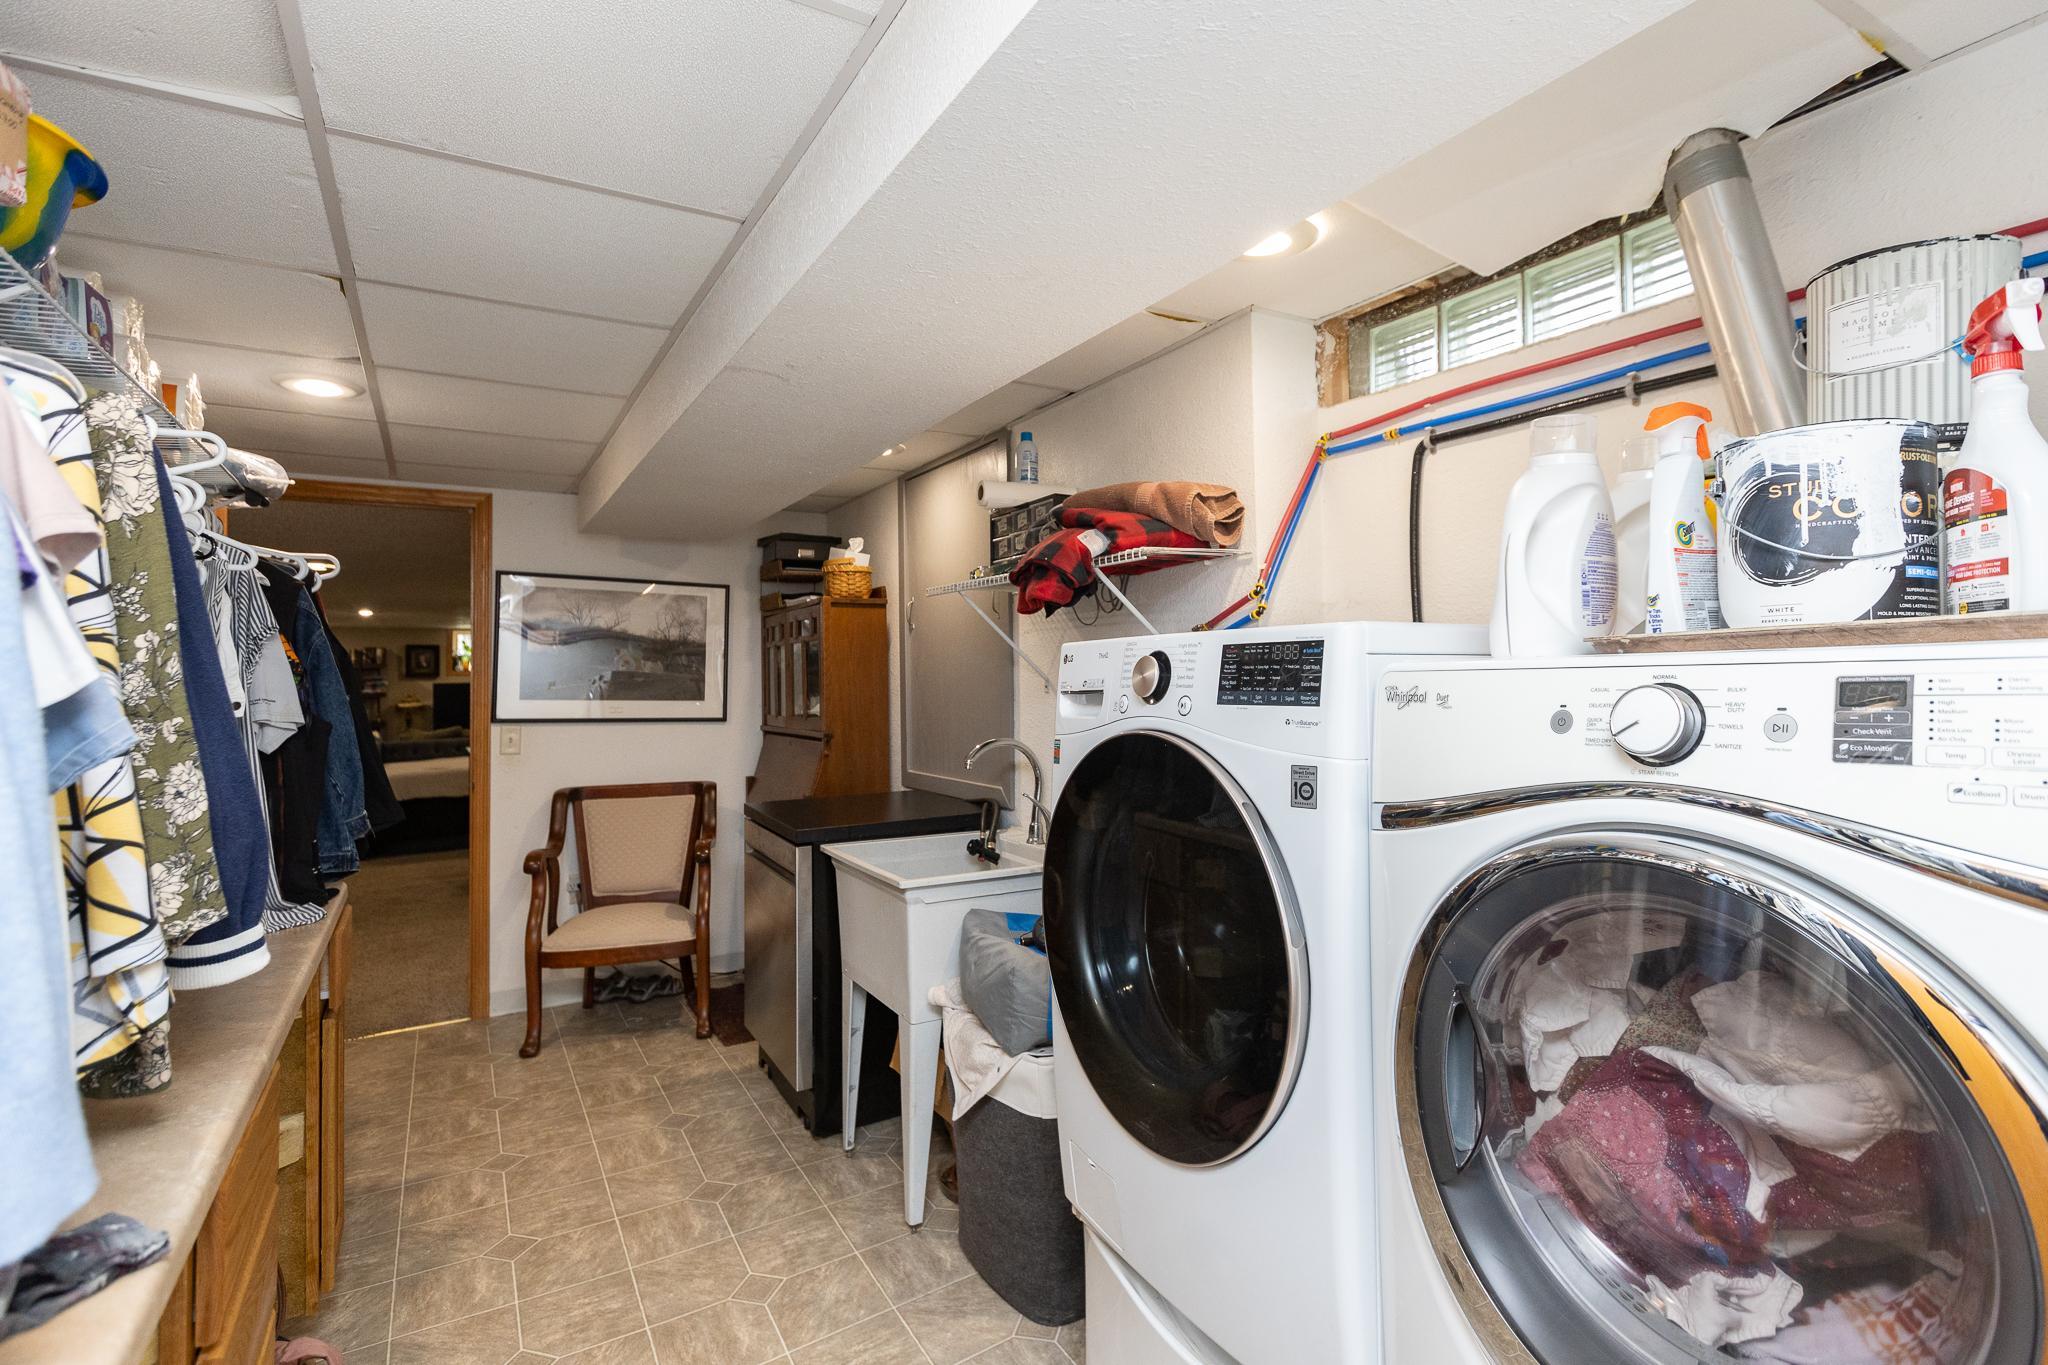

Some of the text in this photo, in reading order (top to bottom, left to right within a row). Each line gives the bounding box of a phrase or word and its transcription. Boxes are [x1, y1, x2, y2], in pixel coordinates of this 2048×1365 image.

[1386, 687, 1427, 707] Whirlpool
[1436, 692, 1449, 703] Duet
[1852, 727, 1892, 735] Check Vent
[1849, 744, 1893, 752] Eco Monitor
[1945, 752, 1967, 760] Temp
[1293, 781, 1314, 801] 10
